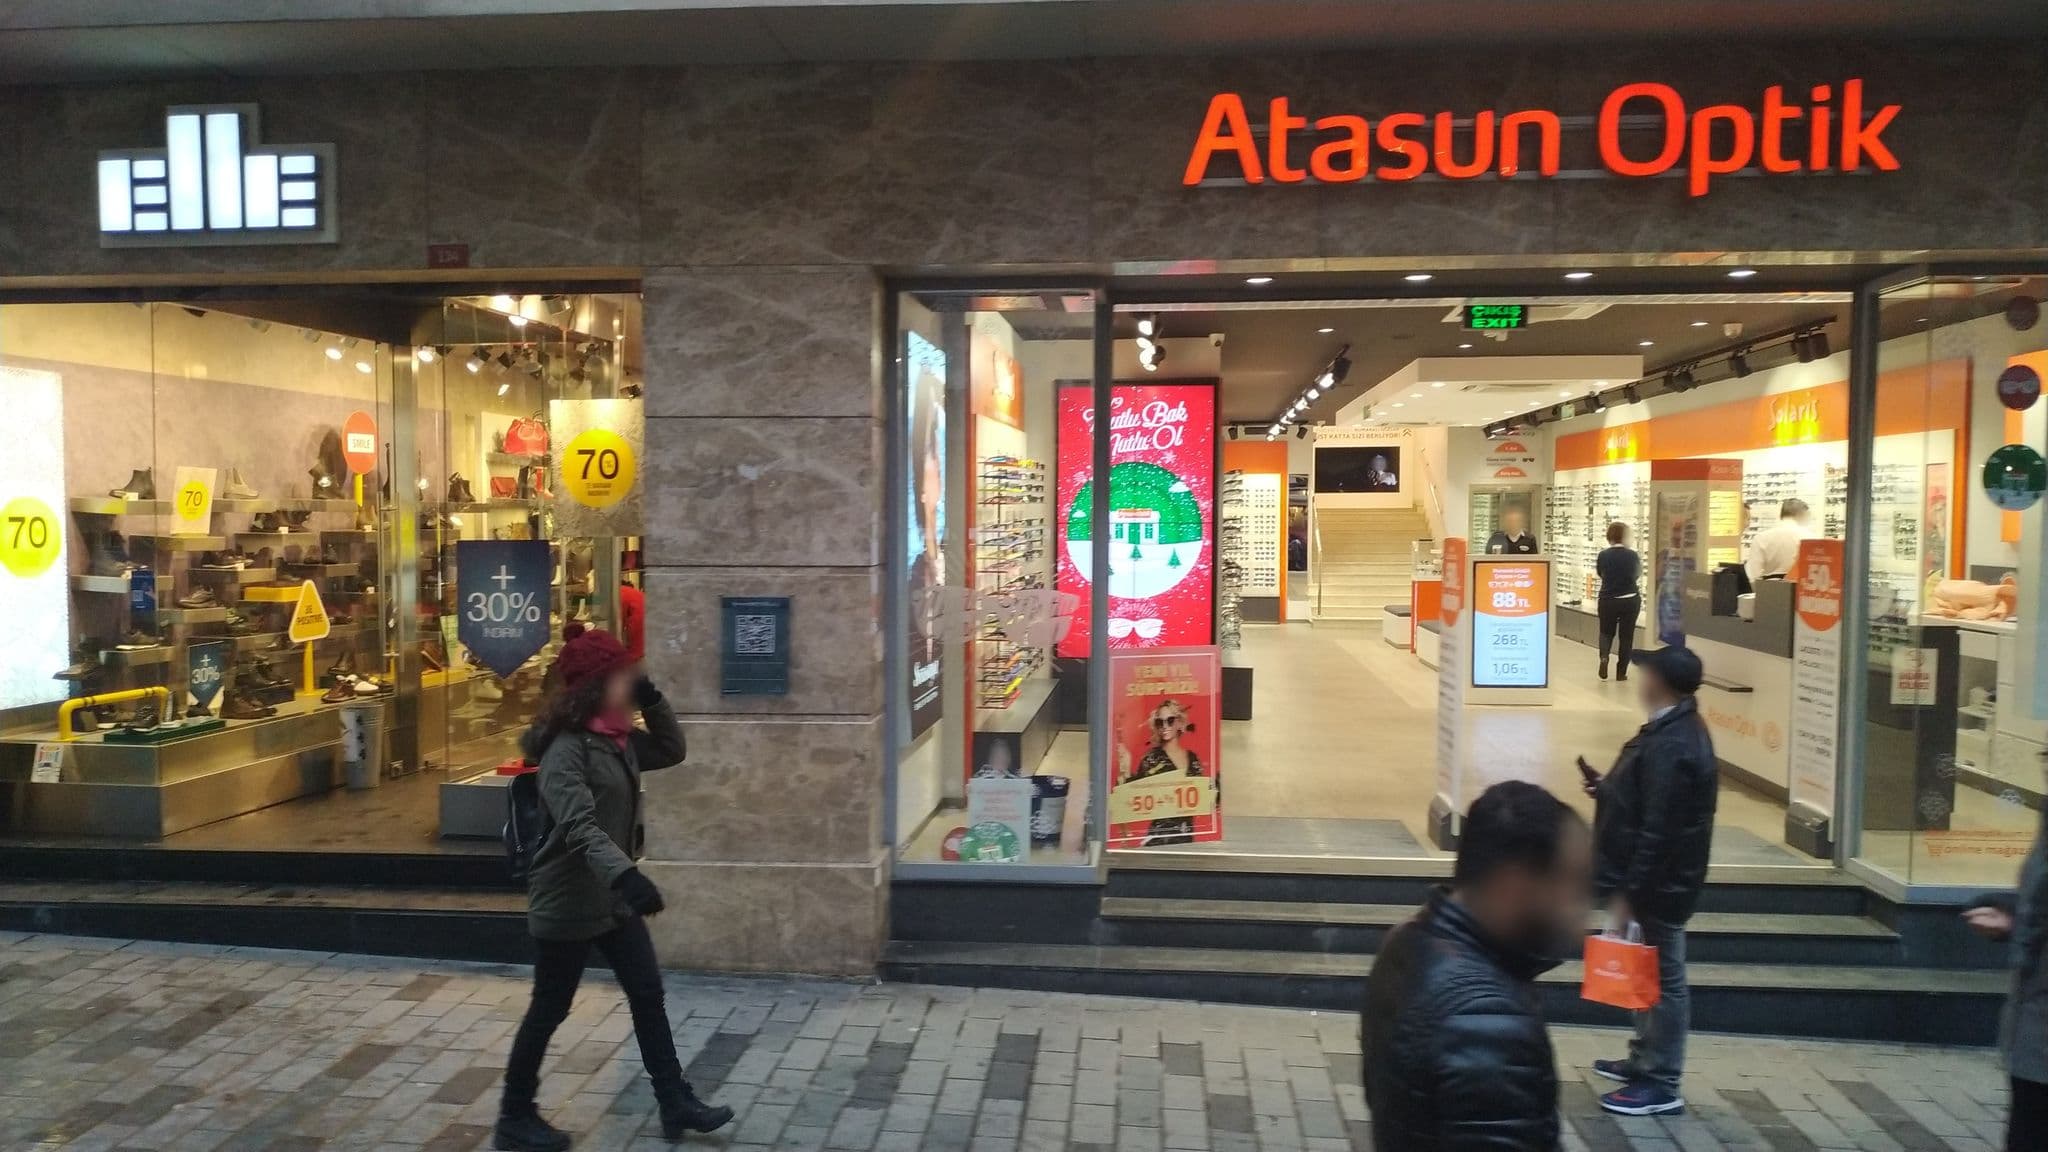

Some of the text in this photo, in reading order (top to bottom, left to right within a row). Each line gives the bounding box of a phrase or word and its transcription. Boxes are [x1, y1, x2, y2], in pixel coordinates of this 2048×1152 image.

[1183, 78, 1902, 197] Atasun Optik
[1471, 317, 1521, 328] EXIT
[1141, 400, 1187, 428] Bak
[1152, 424, 1185, 450] Ol
[577, 448, 620, 480] 70
[185, 490, 203, 507] 70
[8, 516, 47, 549] 70
[466, 591, 541, 623] 30%
[1492, 591, 1531, 608] 88 TL
[1492, 634, 1518, 646] 268
[191, 665, 221, 684] 30%
[1132, 794, 1154, 811] 50
